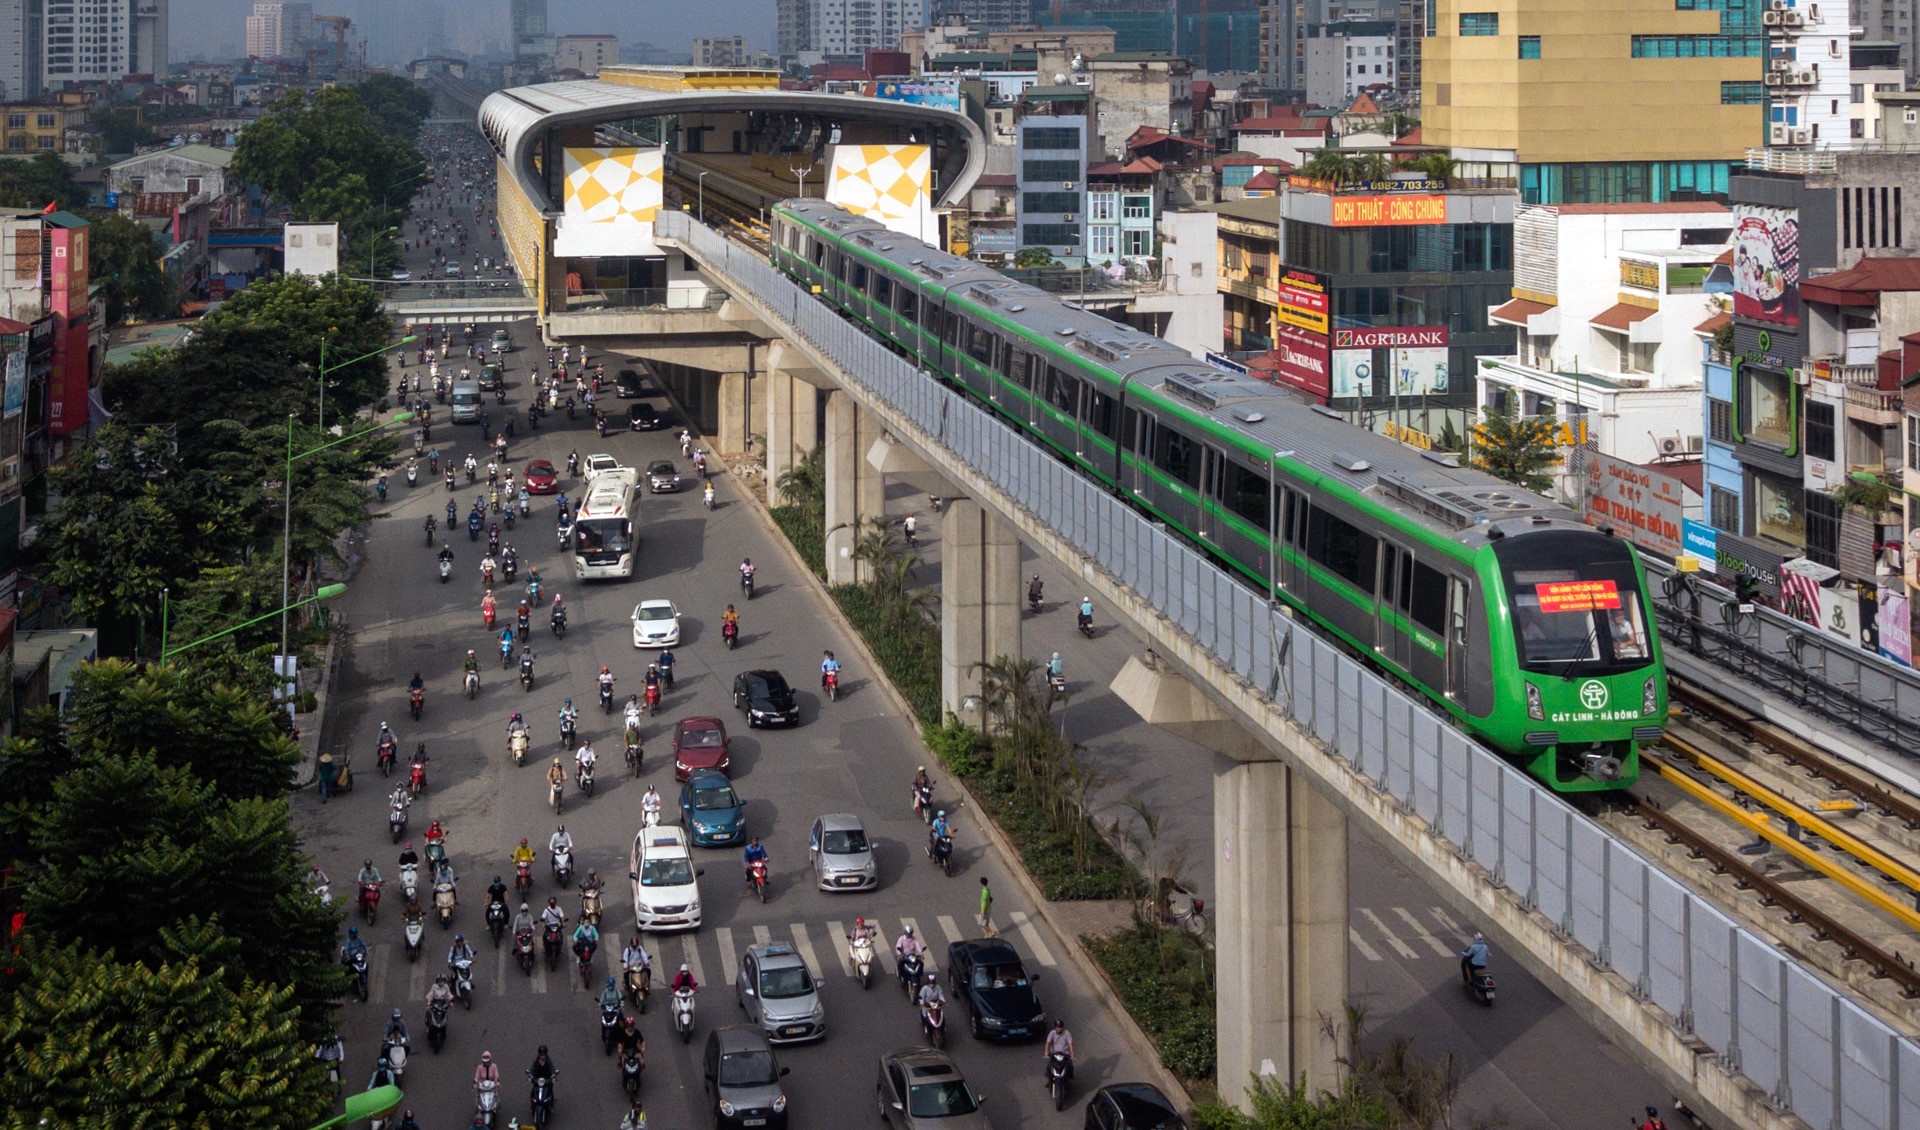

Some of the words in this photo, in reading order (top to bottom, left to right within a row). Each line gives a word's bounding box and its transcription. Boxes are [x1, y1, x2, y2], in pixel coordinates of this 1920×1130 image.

[1370, 180, 1445, 191] 0982.703.255
[1334, 201, 1354, 225] DỊCH
[1357, 198, 1384, 225] THUẬT
[1390, 197, 1413, 221] CÔNG
[1353, 331, 1443, 347] AGRIBANK
[1289, 350, 1324, 374] AGRIBANK
[1610, 501, 1646, 530] TRANG
[1663, 520, 1680, 543] DA
[1552, 710, 1571, 723] CÁT
[1572, 712, 1593, 722] LINH
[1600, 710, 1613, 721] HÀ
